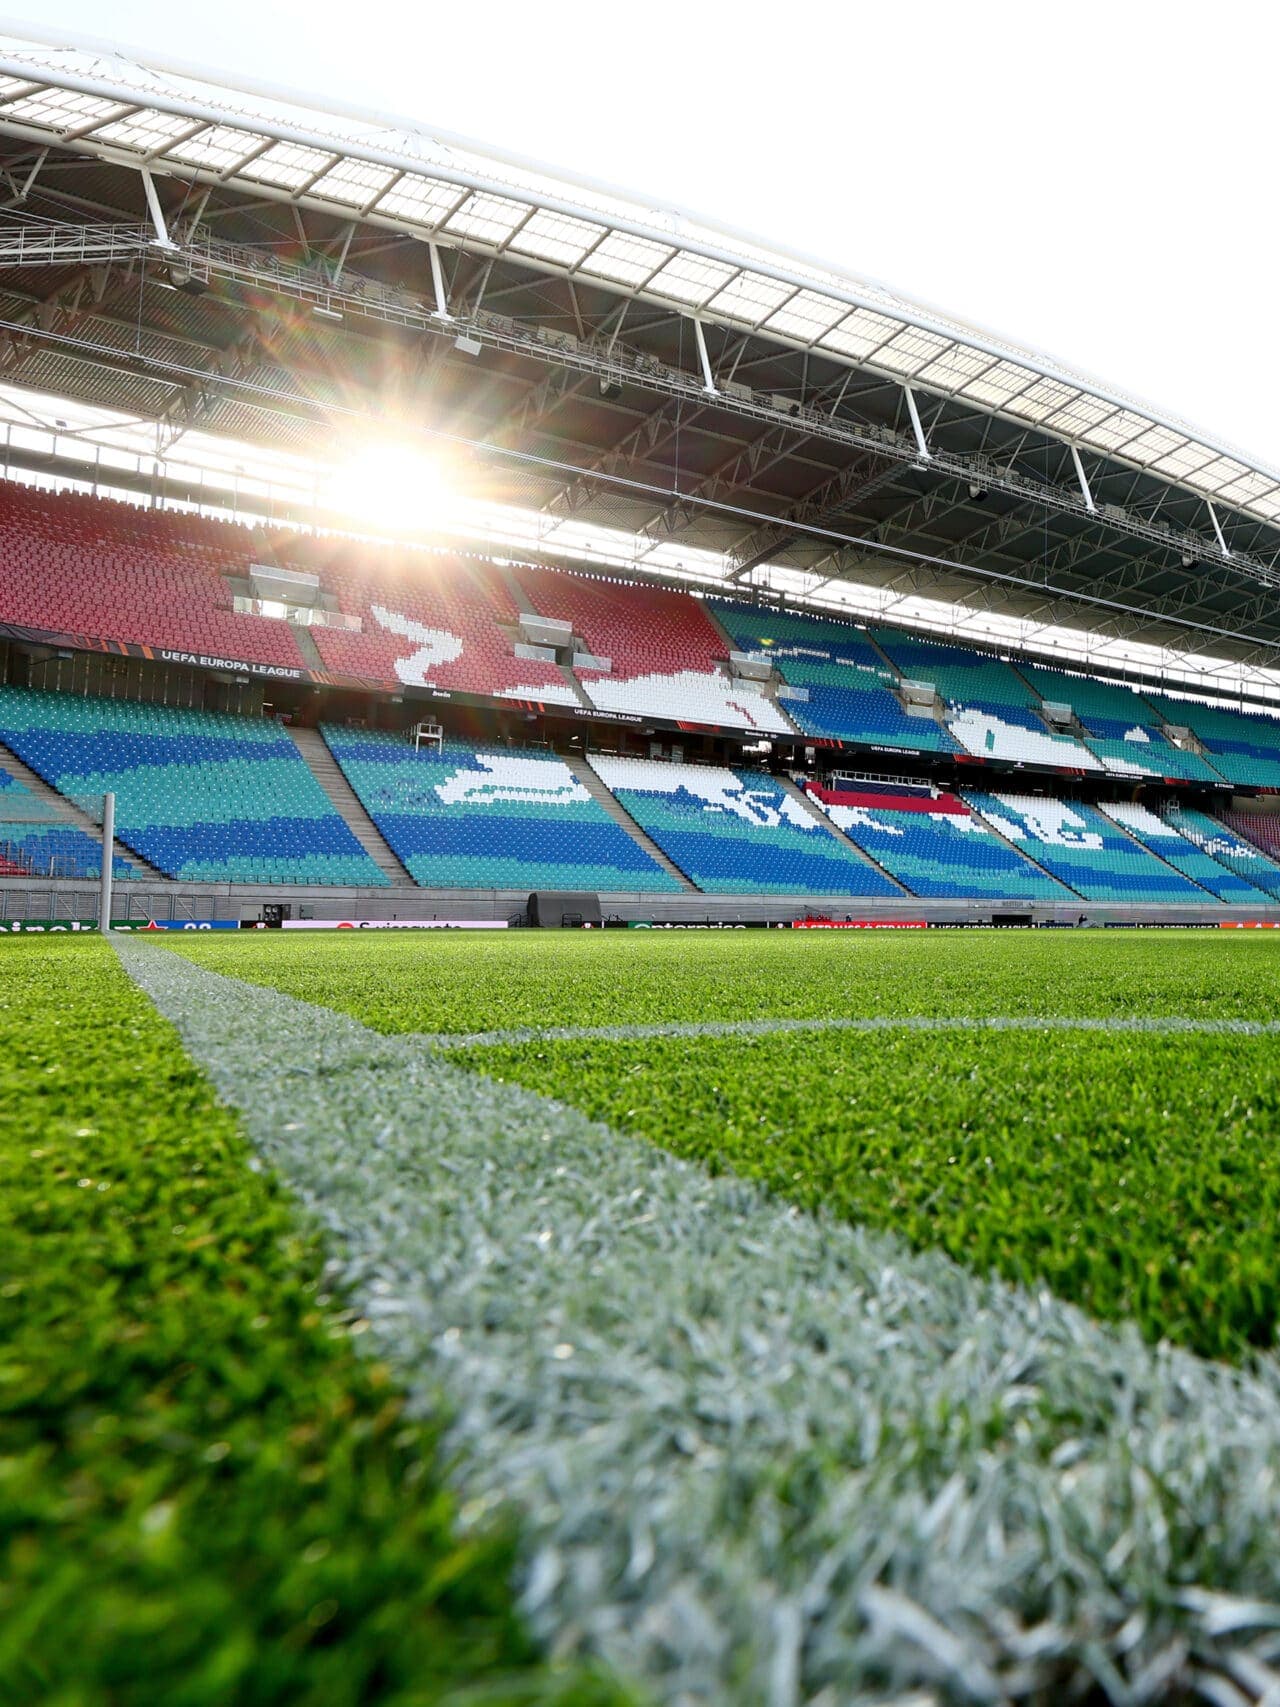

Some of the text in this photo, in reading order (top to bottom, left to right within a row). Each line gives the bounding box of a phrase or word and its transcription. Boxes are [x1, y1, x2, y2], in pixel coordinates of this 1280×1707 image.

[161, 650, 301, 678] UEFA EUROPA LEAGUE
[574, 708, 642, 722] UEFA EUROPA LEAGUE
[902, 748, 920, 756] LEAGUE
